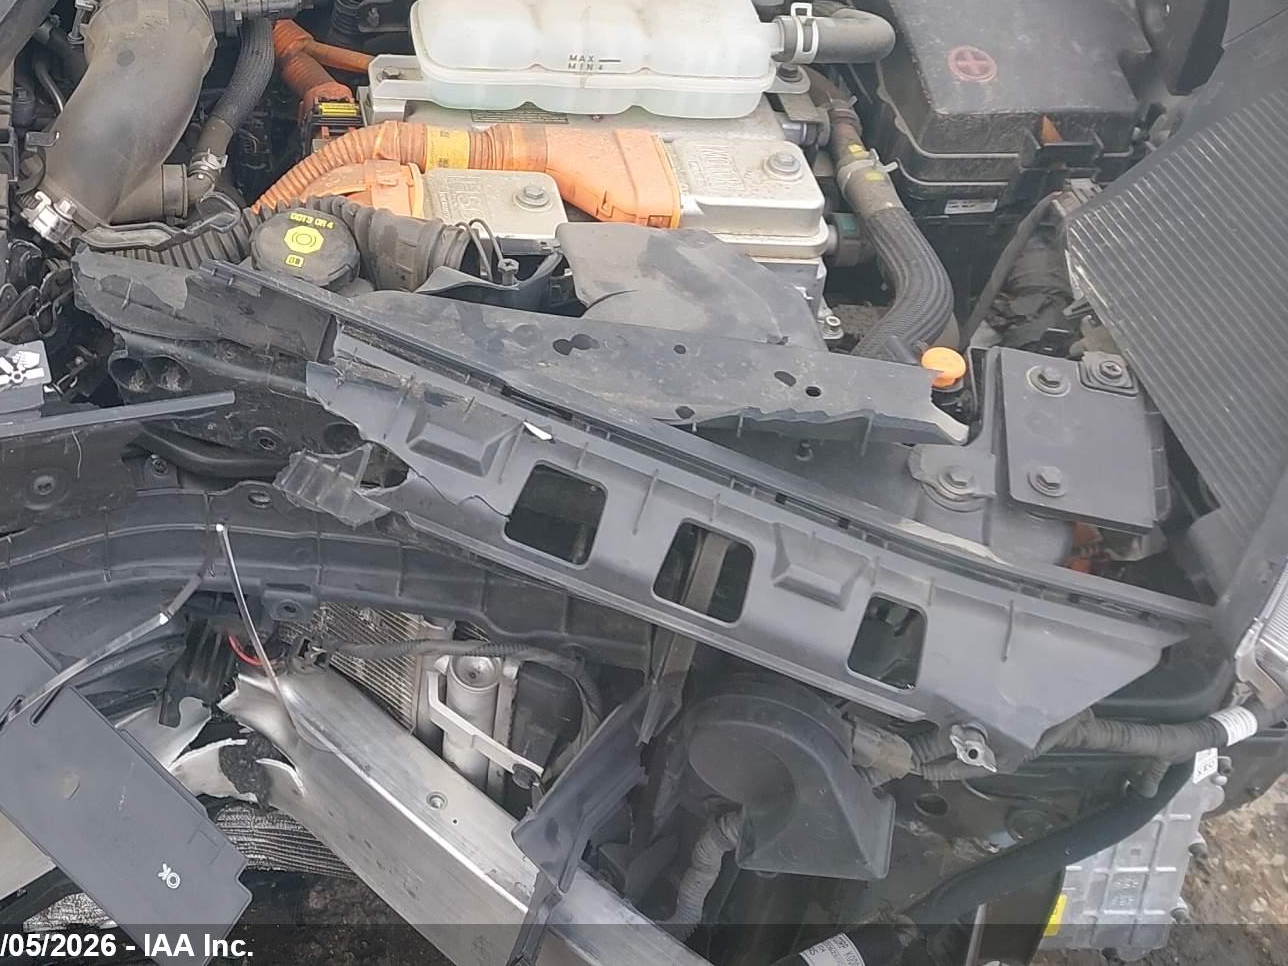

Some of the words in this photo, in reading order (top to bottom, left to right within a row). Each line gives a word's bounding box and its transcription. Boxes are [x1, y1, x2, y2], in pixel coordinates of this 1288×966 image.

[569, 54, 594, 62] MAX
[569, 63, 593, 71] MIN
[314, 218, 327, 228] OR
[158, 863, 181, 889] OK
